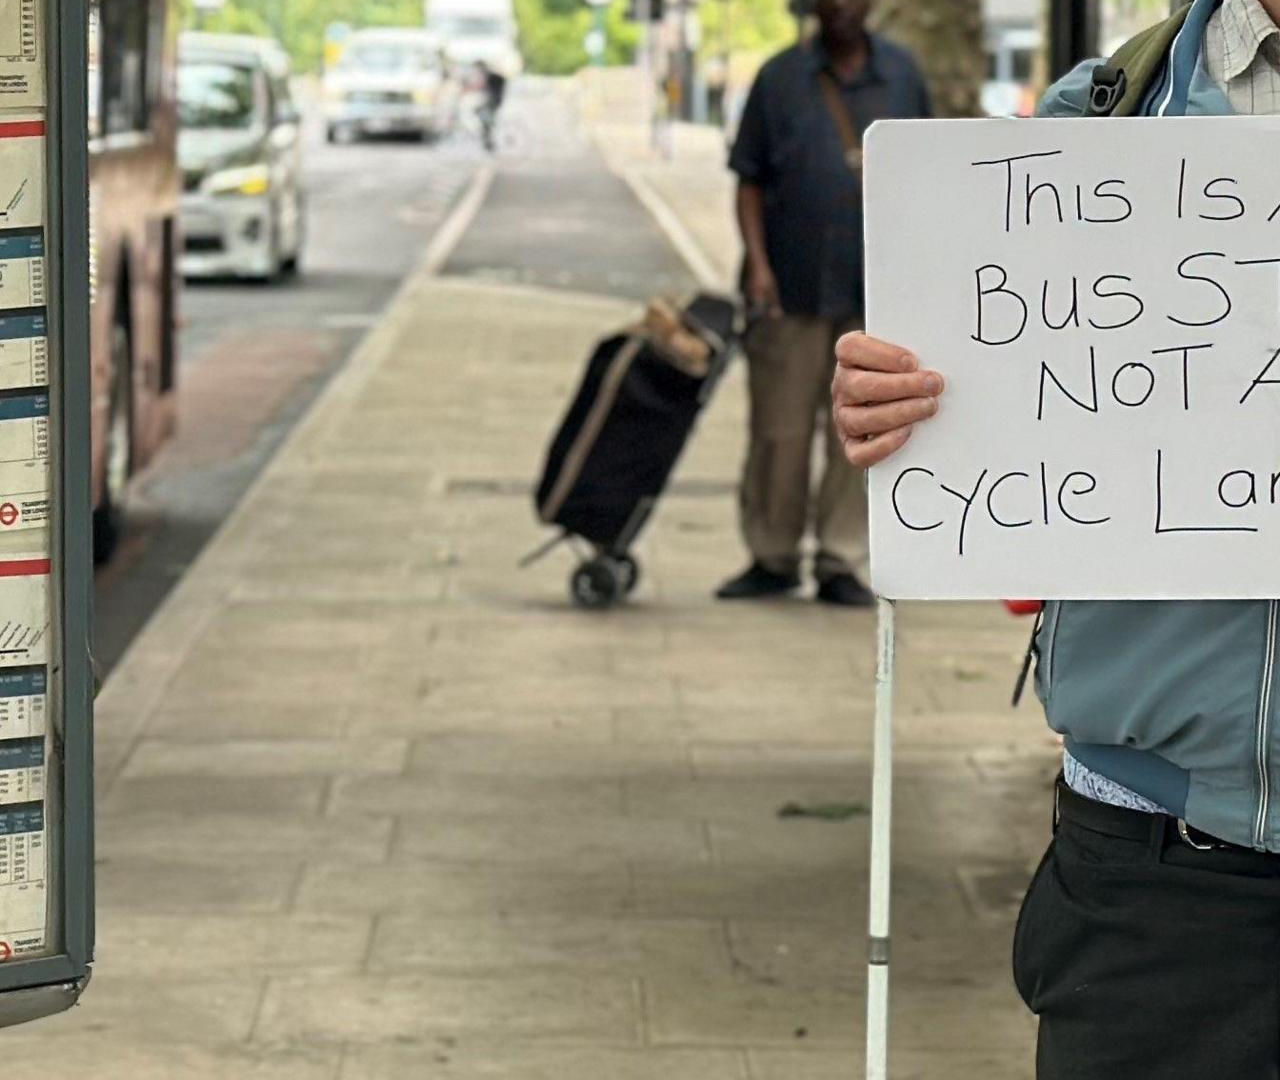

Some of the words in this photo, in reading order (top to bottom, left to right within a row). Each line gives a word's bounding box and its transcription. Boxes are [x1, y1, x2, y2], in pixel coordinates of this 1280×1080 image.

[972, 150, 1133, 232] This
[1177, 158, 1246, 221] Is
[971, 264, 1145, 346] Bus
[891, 461, 1111, 555] Cycle
